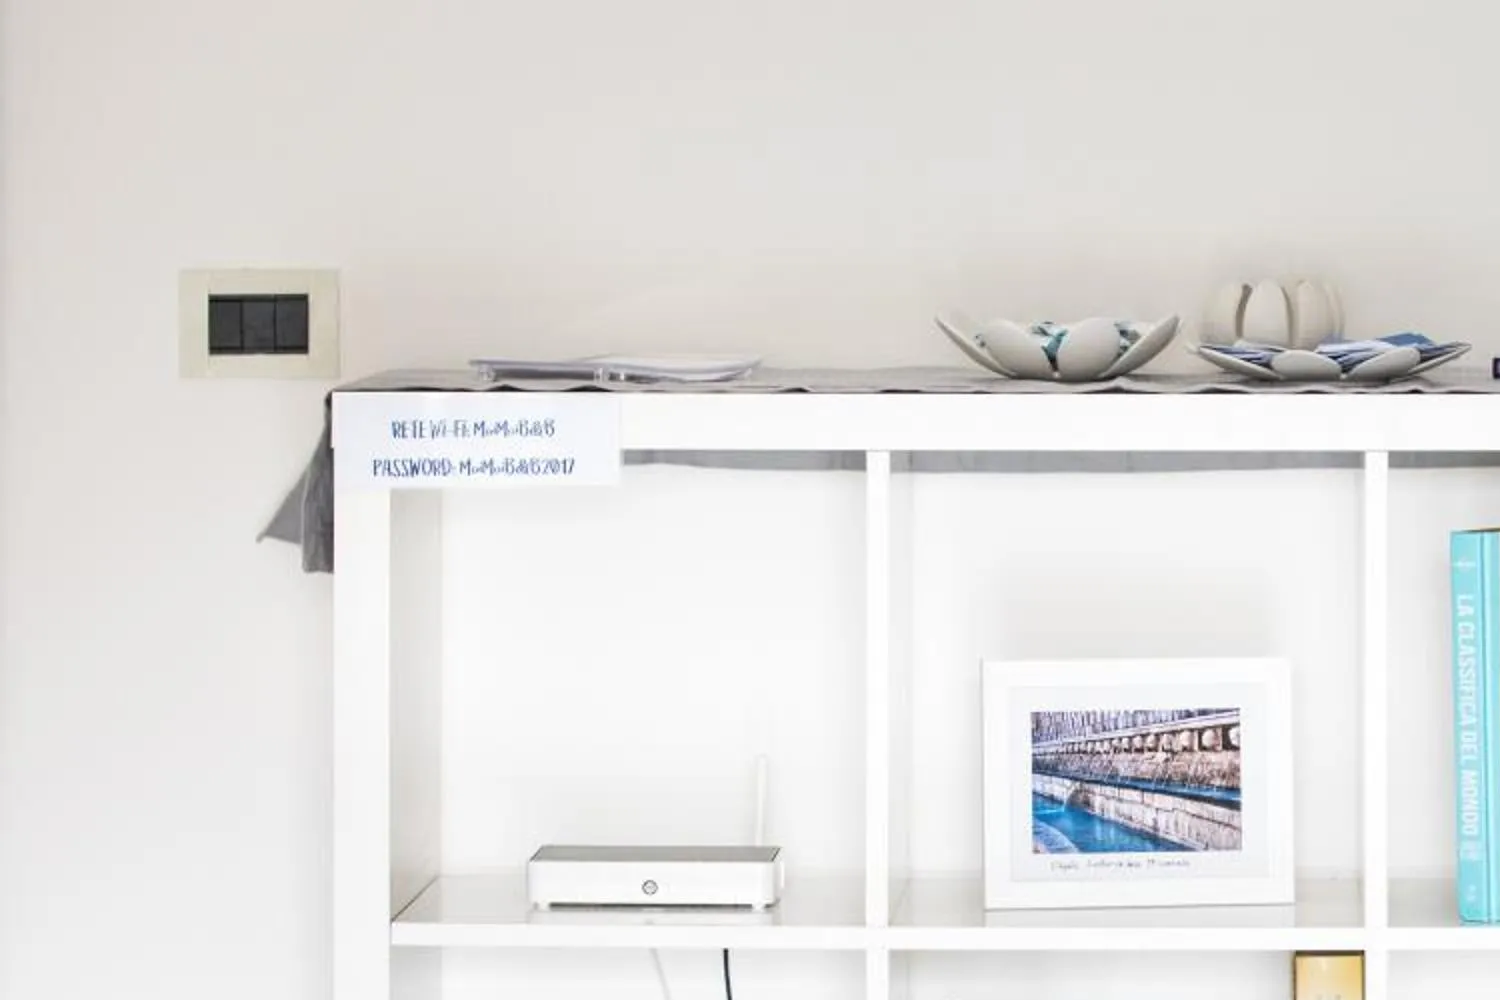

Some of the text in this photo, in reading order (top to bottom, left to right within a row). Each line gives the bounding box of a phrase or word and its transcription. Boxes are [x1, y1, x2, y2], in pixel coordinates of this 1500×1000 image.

[391, 419, 425, 439] RETE
[1457, 594, 1475, 617] LA
[1457, 621, 1477, 727] CLASSIFICA
[1459, 731, 1478, 765] DEL
[1459, 769, 1478, 836] MONDO
